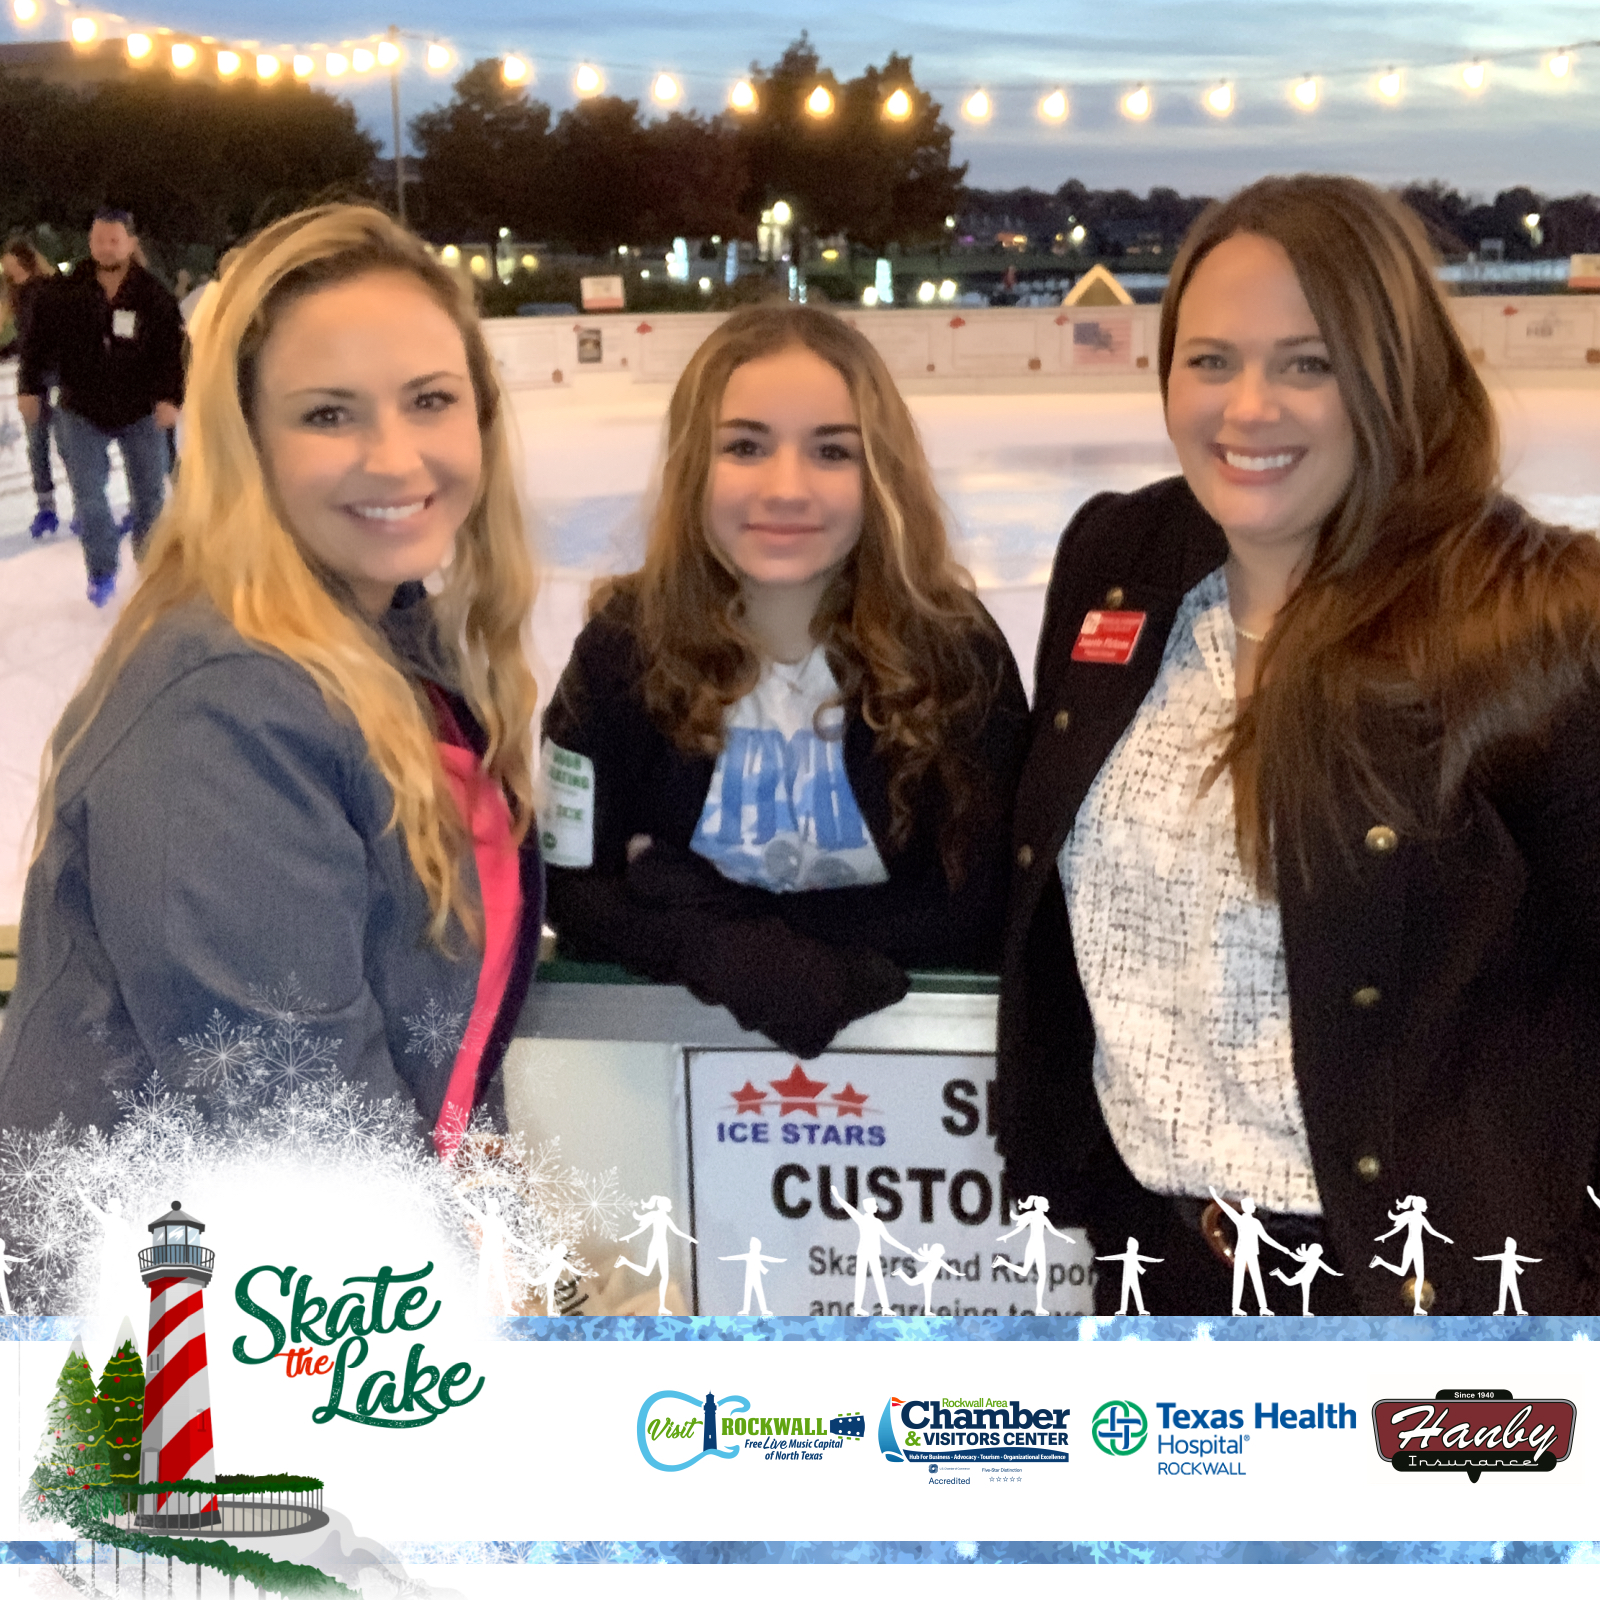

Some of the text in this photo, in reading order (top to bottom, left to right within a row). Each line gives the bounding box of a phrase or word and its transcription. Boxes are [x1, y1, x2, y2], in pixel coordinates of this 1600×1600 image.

[717, 1121, 887, 1147] ICE STARS
[808, 1245, 917, 1280] Skaers
